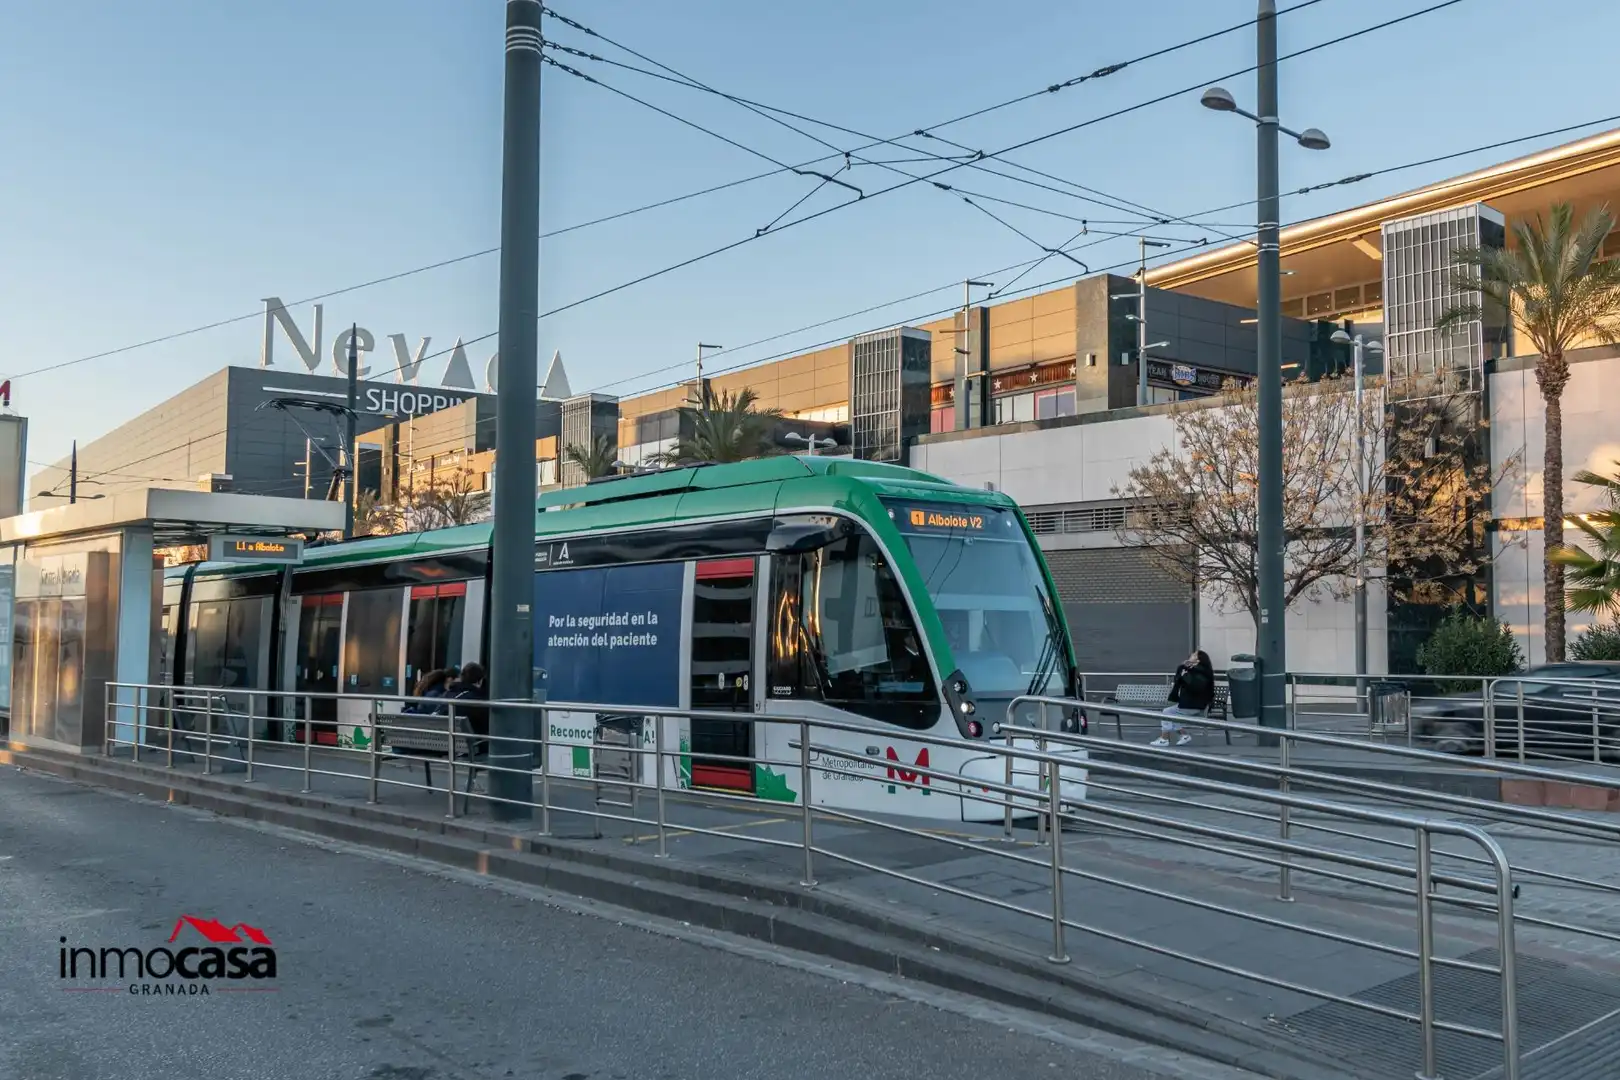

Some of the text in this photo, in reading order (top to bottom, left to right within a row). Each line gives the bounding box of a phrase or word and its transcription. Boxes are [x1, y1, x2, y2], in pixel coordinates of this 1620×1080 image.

[366, 388, 466, 414] SHOPPI
[928, 513, 968, 528] Albolote
[969, 516, 982, 529] V2
[549, 610, 658, 630] Por la seguridad en la
[548, 632, 658, 650] atención del paciente
